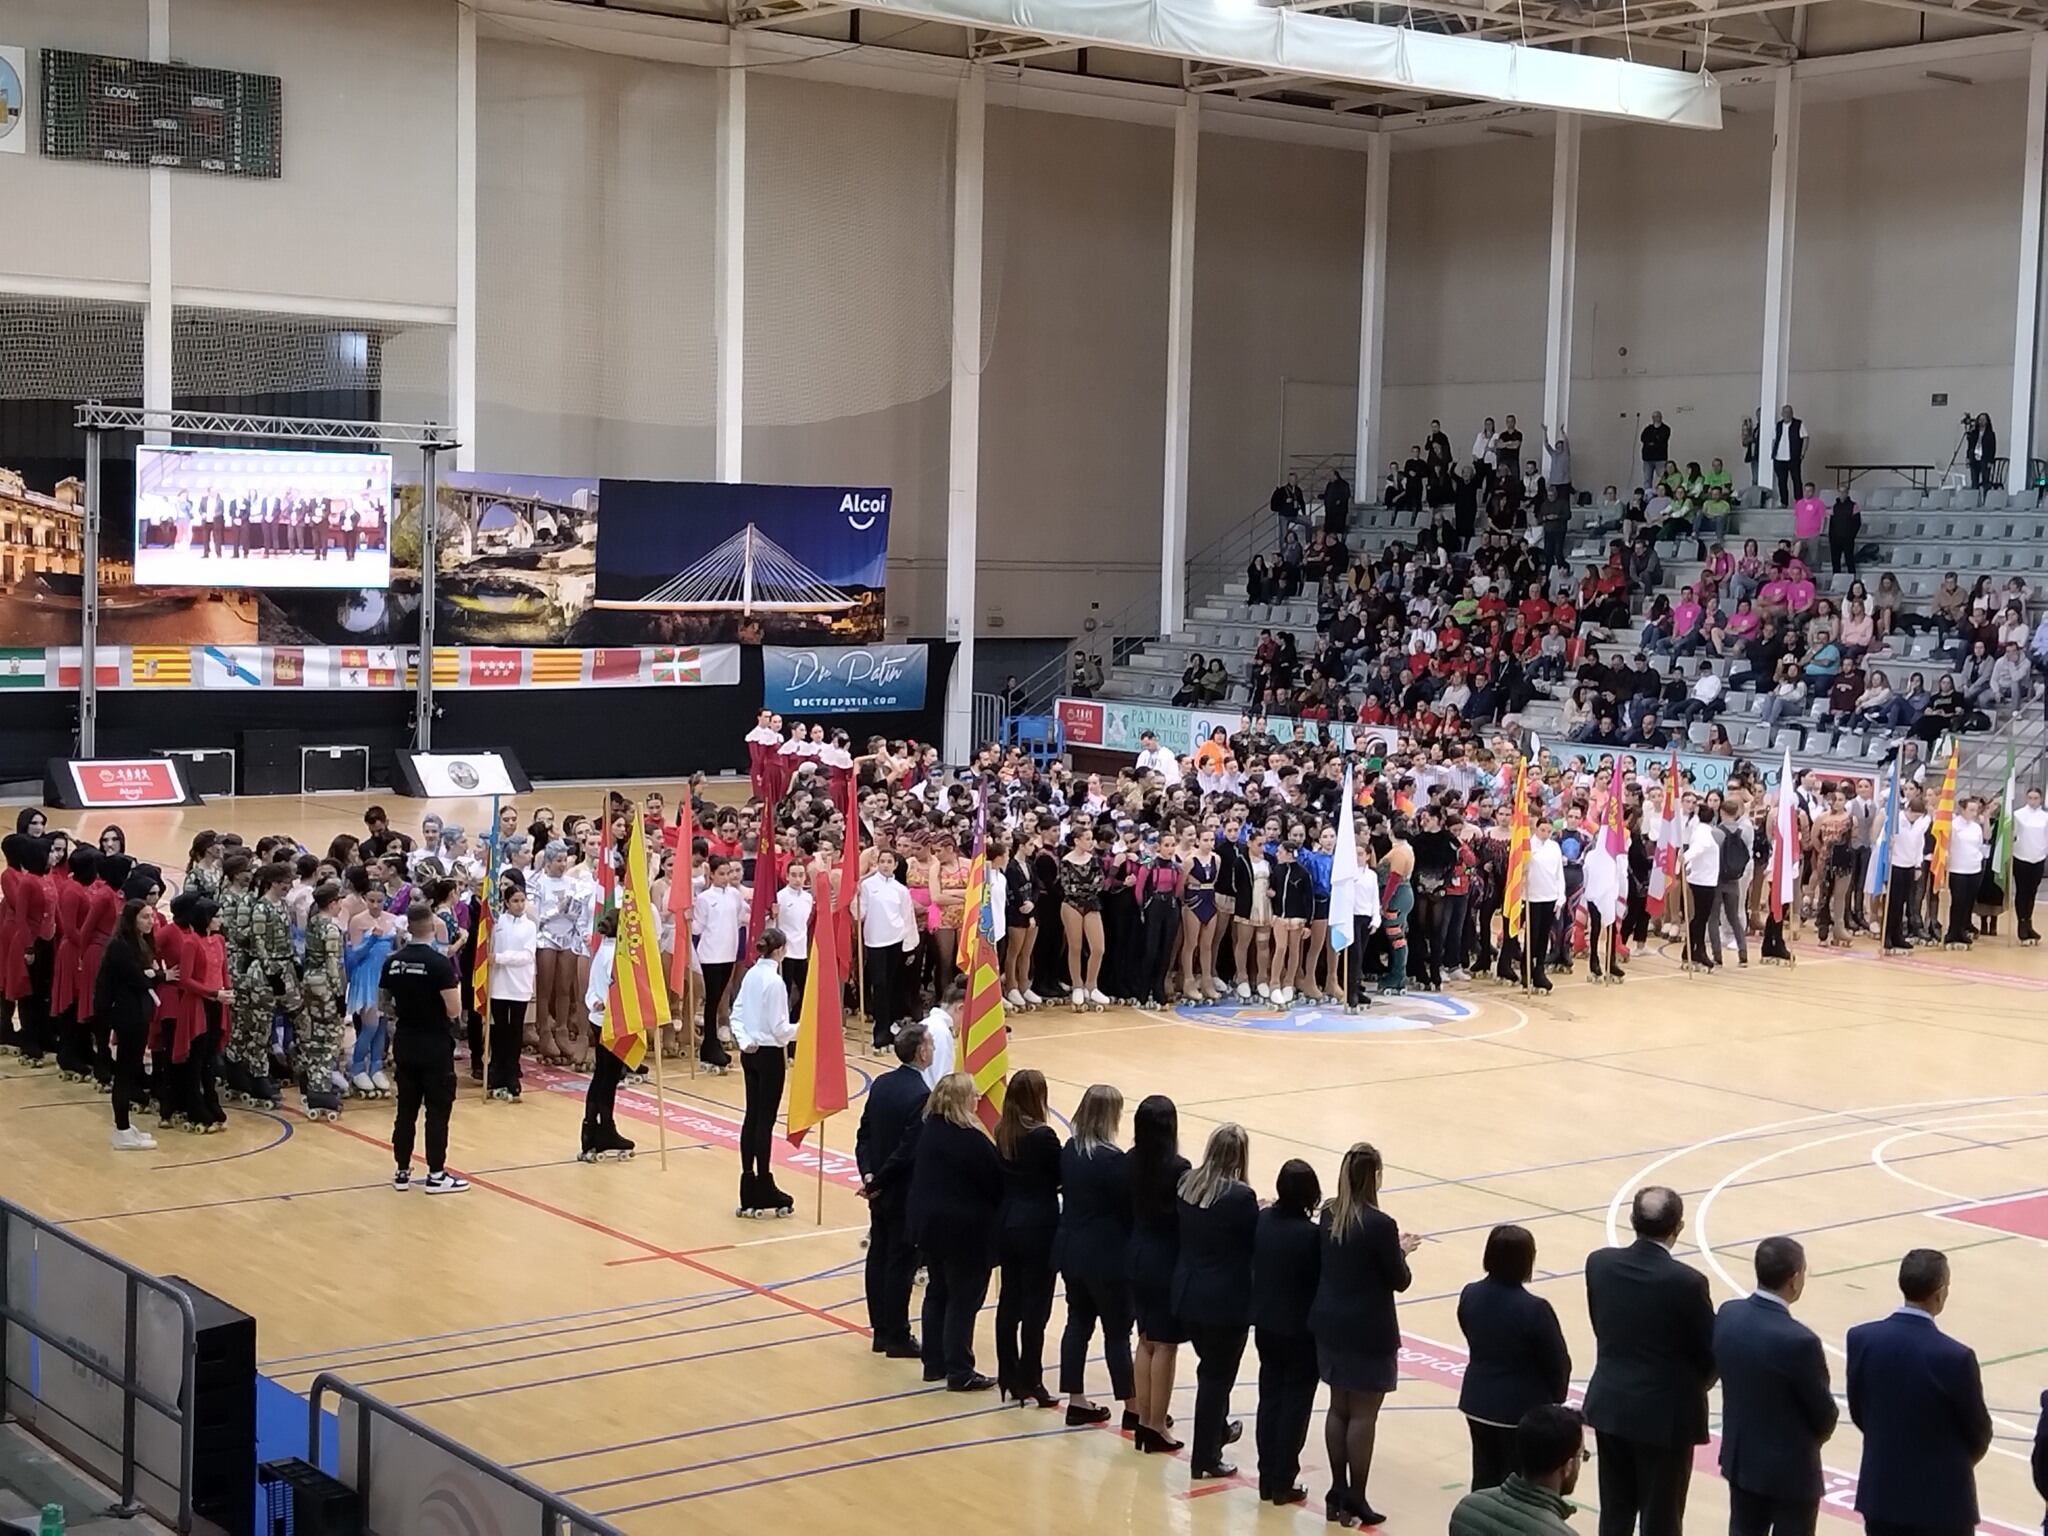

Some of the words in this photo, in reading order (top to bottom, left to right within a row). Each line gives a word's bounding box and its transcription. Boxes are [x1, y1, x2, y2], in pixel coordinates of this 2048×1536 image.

[105, 86, 139, 100] LOCAL
[839, 493, 887, 513] Alcoi
[786, 651, 832, 691] Dr.
